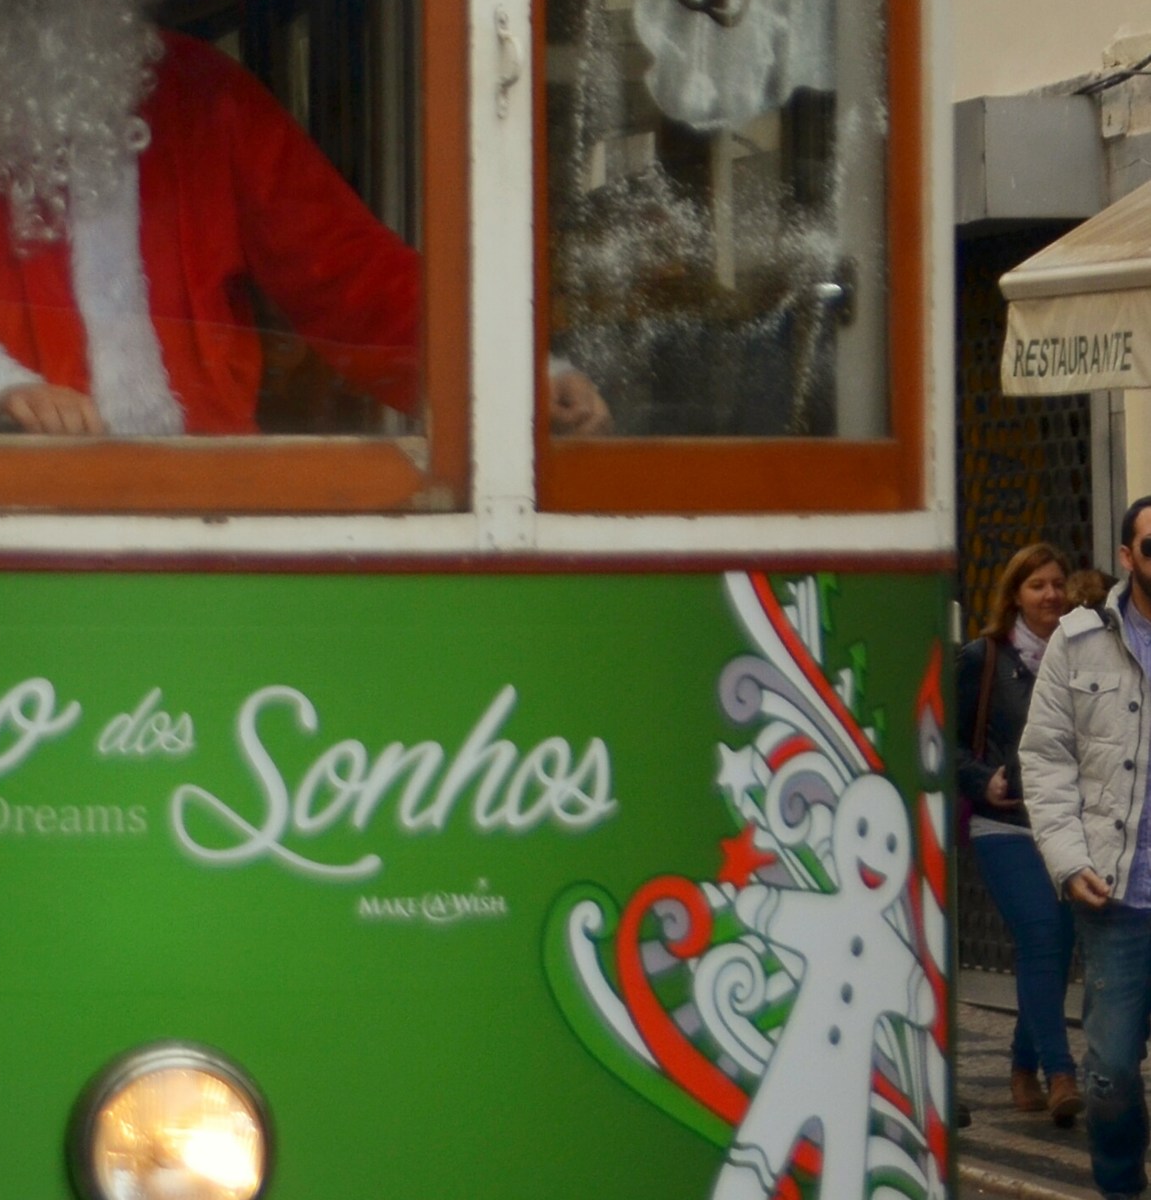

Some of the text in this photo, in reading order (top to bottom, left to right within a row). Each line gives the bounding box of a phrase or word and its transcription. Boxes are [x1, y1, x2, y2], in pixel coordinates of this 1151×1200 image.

[1012, 331, 1134, 378] RESTAURANTE
[96, 686, 196, 757] dos
[170, 684, 618, 878] Sonhos
